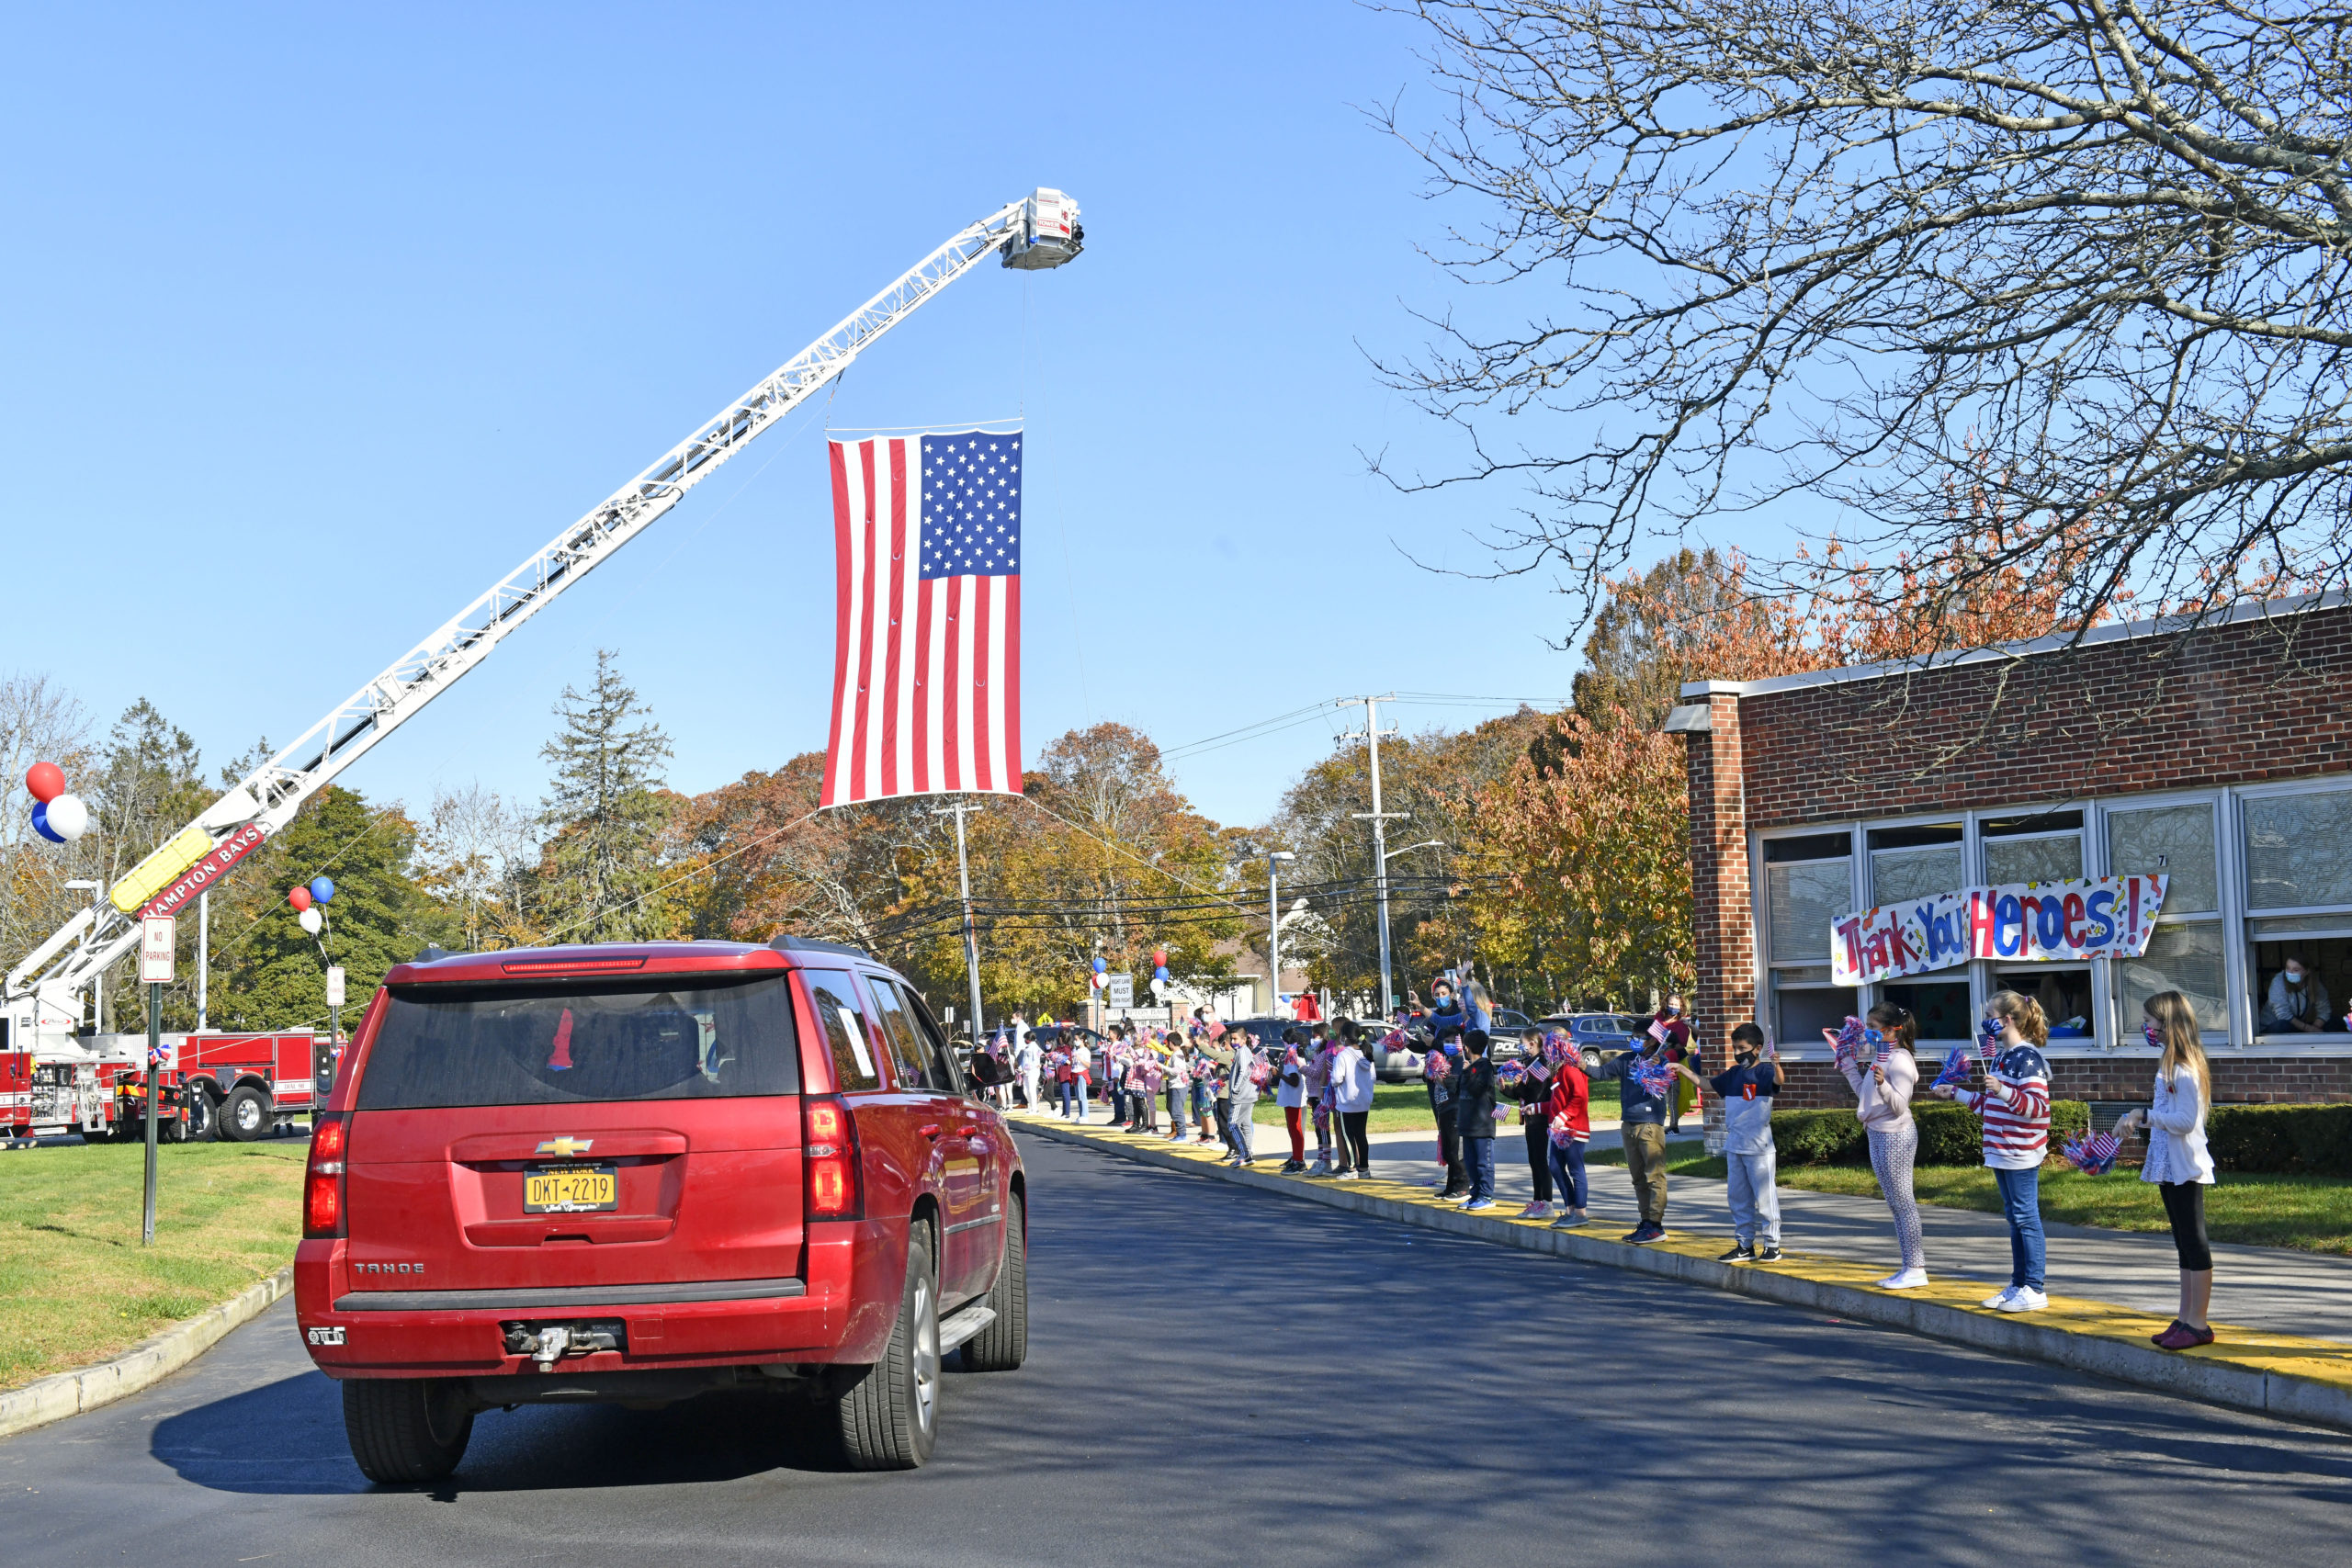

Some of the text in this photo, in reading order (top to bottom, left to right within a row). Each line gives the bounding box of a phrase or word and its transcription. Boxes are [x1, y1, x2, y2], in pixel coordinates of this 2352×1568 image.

[2158, 855, 2165, 866] 7
[143, 829, 258, 917] HAMPTON BAYS
[153, 931, 163, 942] NO
[1838, 910, 1920, 978] Thank
[1915, 901, 1964, 964] You
[145, 951, 171, 962] PARKING
[1494, 1042, 1520, 1052] POL
[548, 1167, 594, 1176] NEW YORK
[571, 1178, 608, 1201] 2219
[354, 1263, 424, 1274] TAHOE
